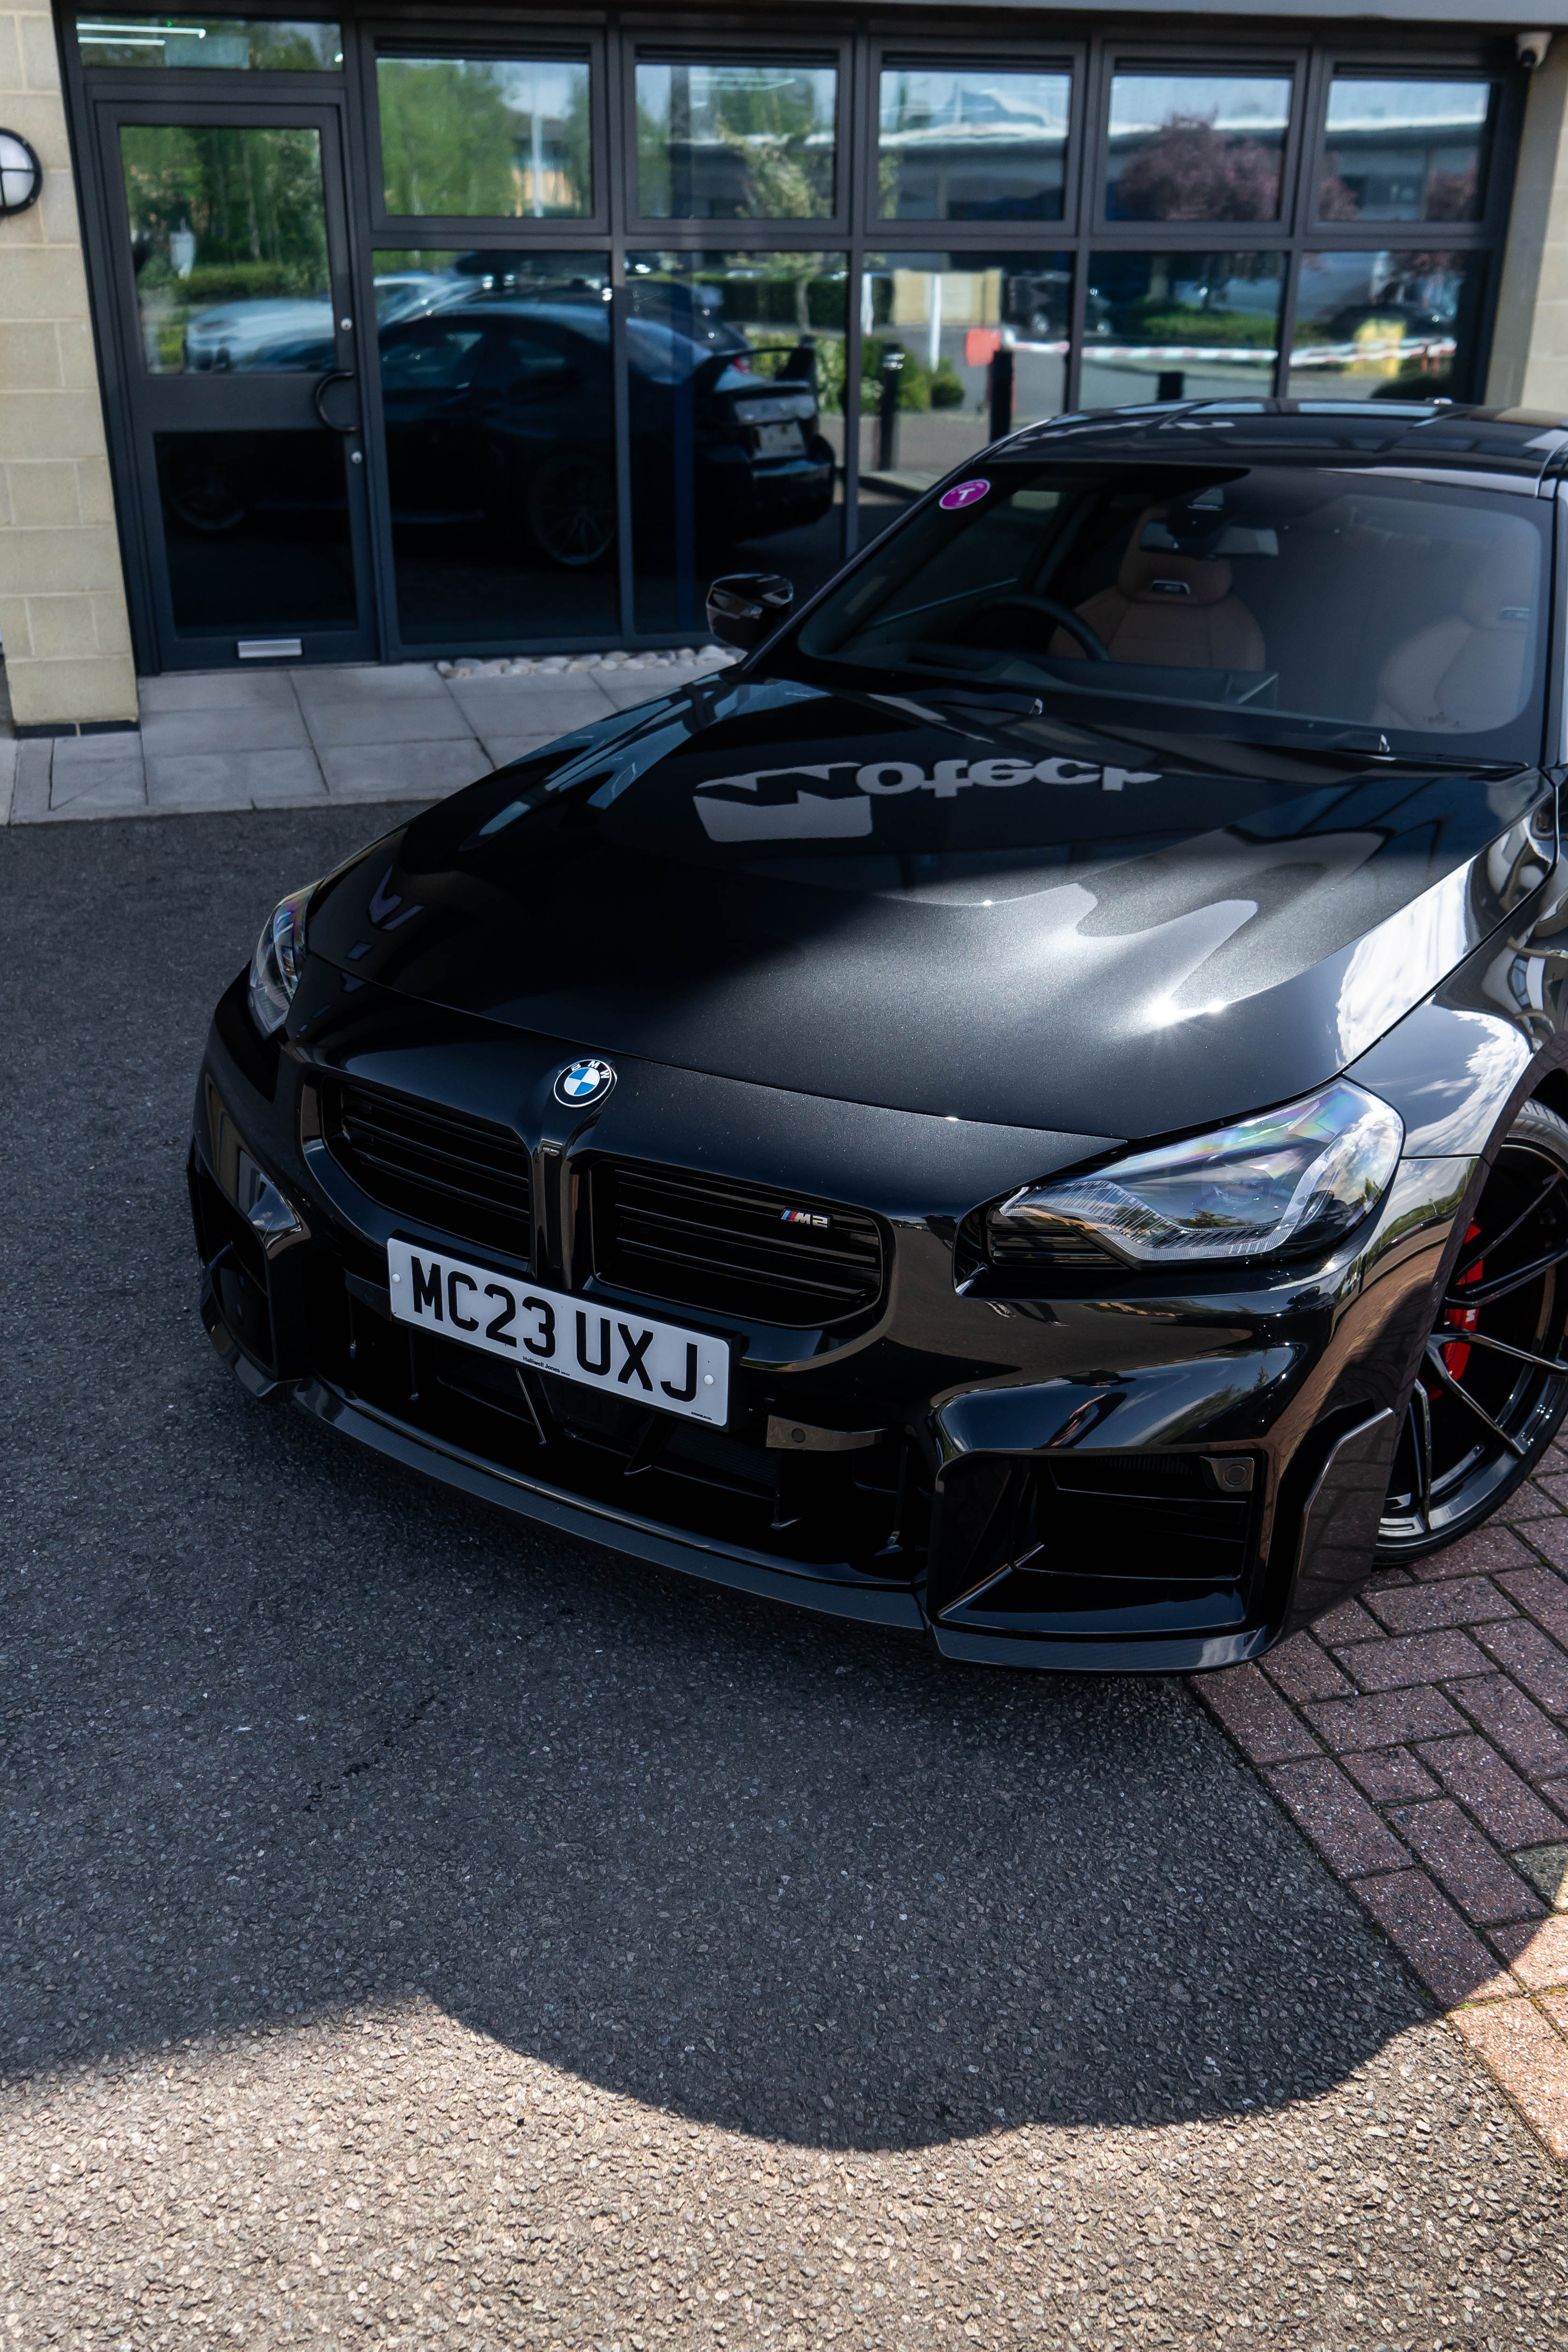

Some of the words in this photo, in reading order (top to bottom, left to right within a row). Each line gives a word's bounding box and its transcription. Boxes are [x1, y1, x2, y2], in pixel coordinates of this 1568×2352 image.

[570, 1060, 610, 1079] BMW
[793, 1212, 829, 1228] M2
[411, 1255, 556, 1358] MC23
[575, 1310, 698, 1402] UXJ
[523, 1356, 544, 1367] Halliwell
[544, 1363, 560, 1373] Jones
